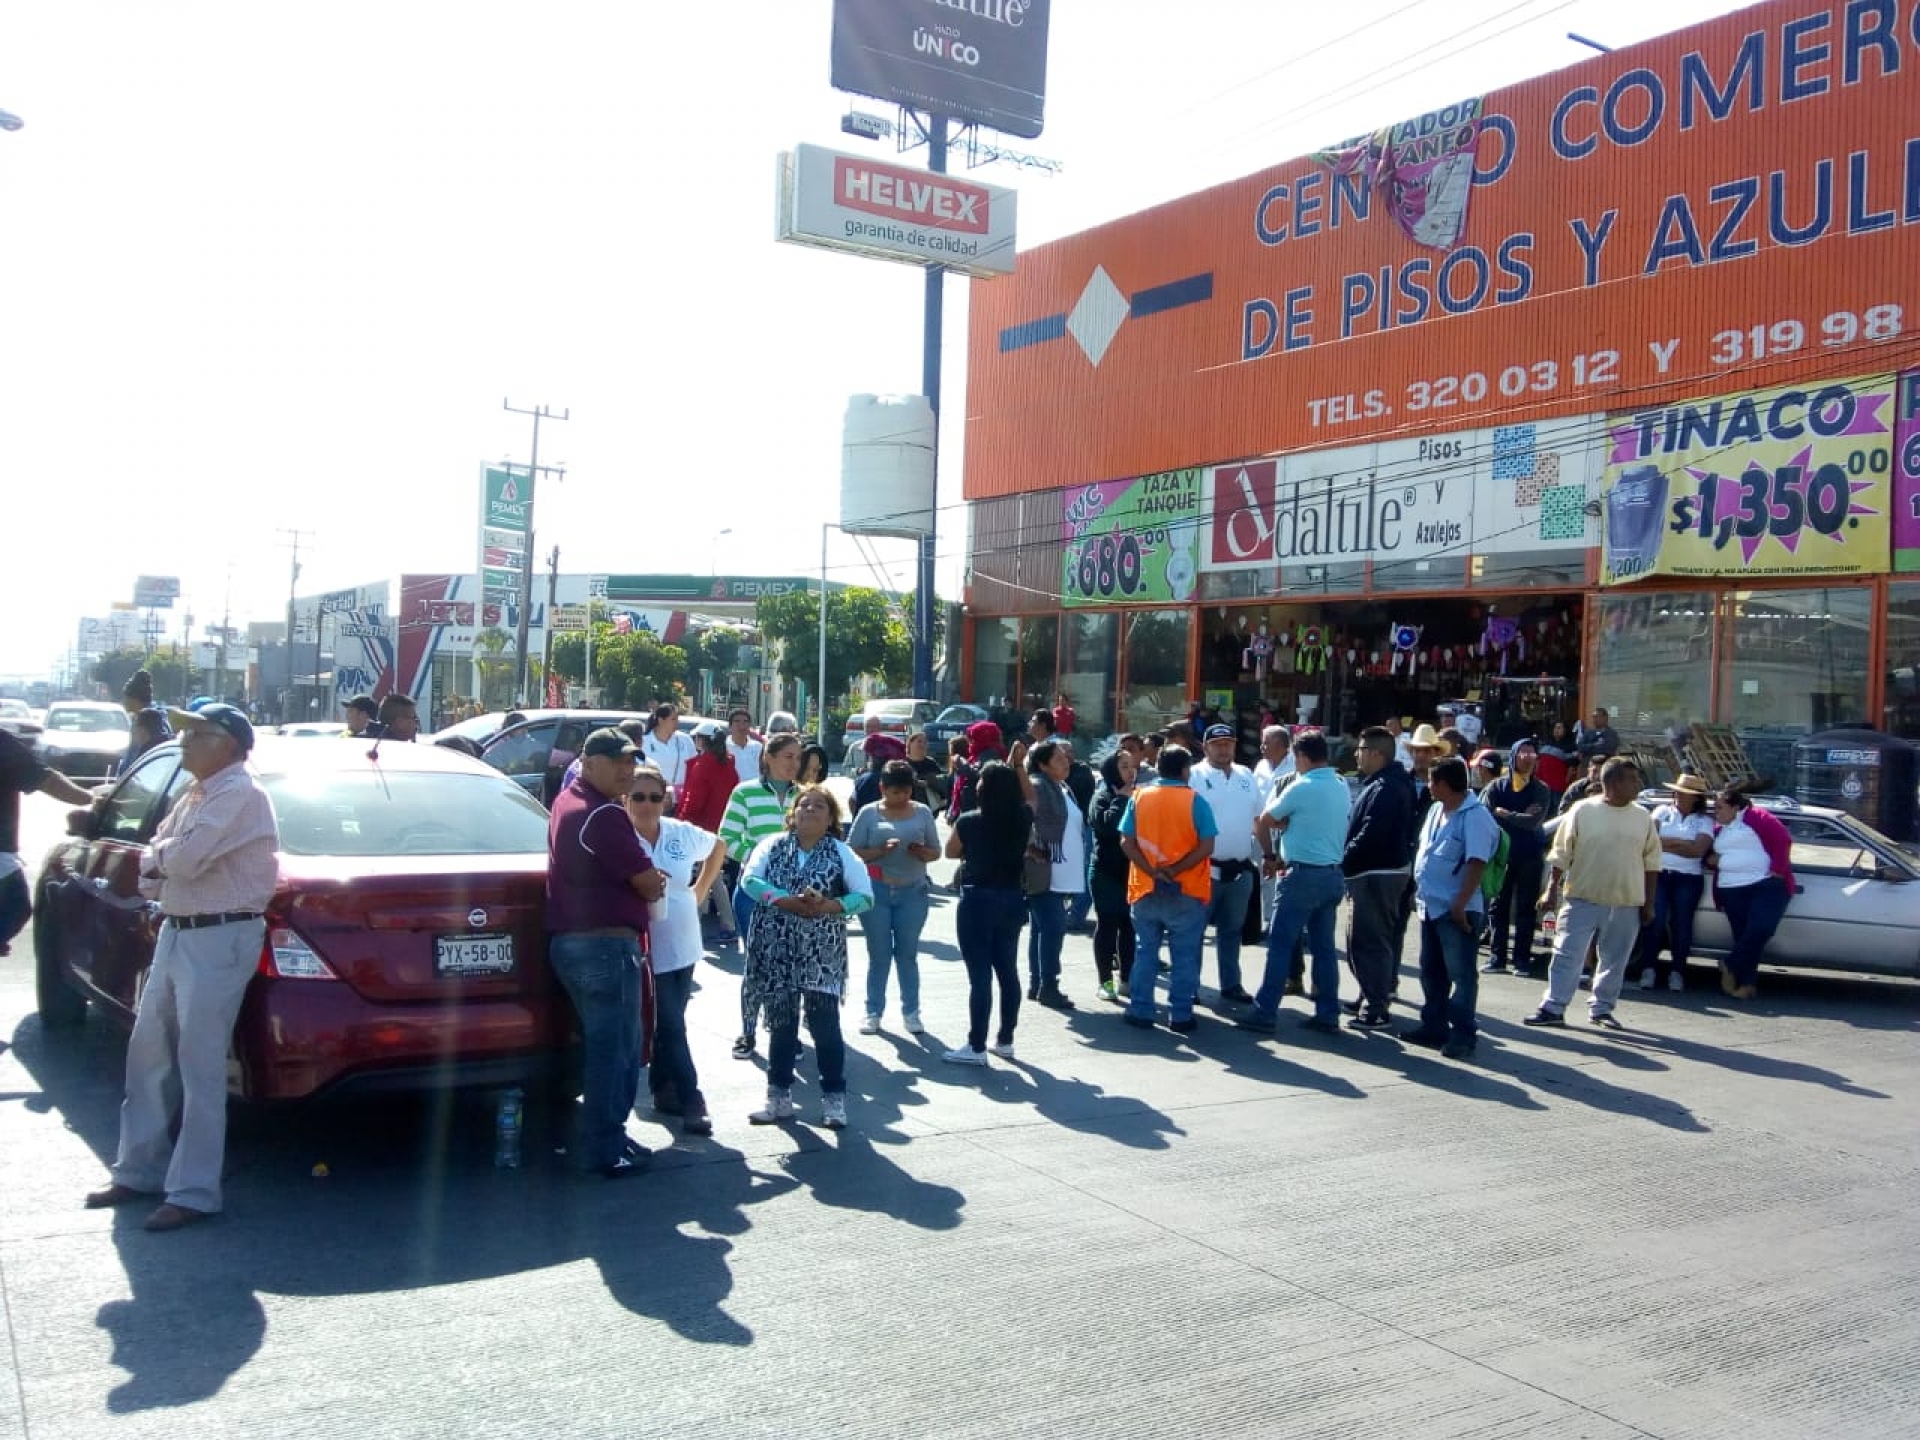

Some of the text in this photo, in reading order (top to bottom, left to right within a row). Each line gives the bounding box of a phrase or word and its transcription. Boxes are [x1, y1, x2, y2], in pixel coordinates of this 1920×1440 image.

[912, 26, 979, 66] ÚNICO
[1254, 0, 1920, 247] CENO COMER
[845, 167, 979, 224] HELVEX
[906, 228, 925, 247] de
[928, 234, 978, 256] calidad
[1242, 284, 1314, 361] DE
[1341, 232, 1534, 339] PISOS
[1568, 209, 1618, 287] Y
[1308, 303, 1902, 427] TELS. 320 03 12 Y 319 98
[1632, 384, 1858, 457] TINACO
[1418, 439, 1462, 461] Pisos
[1143, 471, 1195, 494] TAZA Y
[491, 500, 525, 516] PEMEX
[1137, 492, 1196, 514] TANQUE
[1415, 519, 1462, 546] Azulejos
